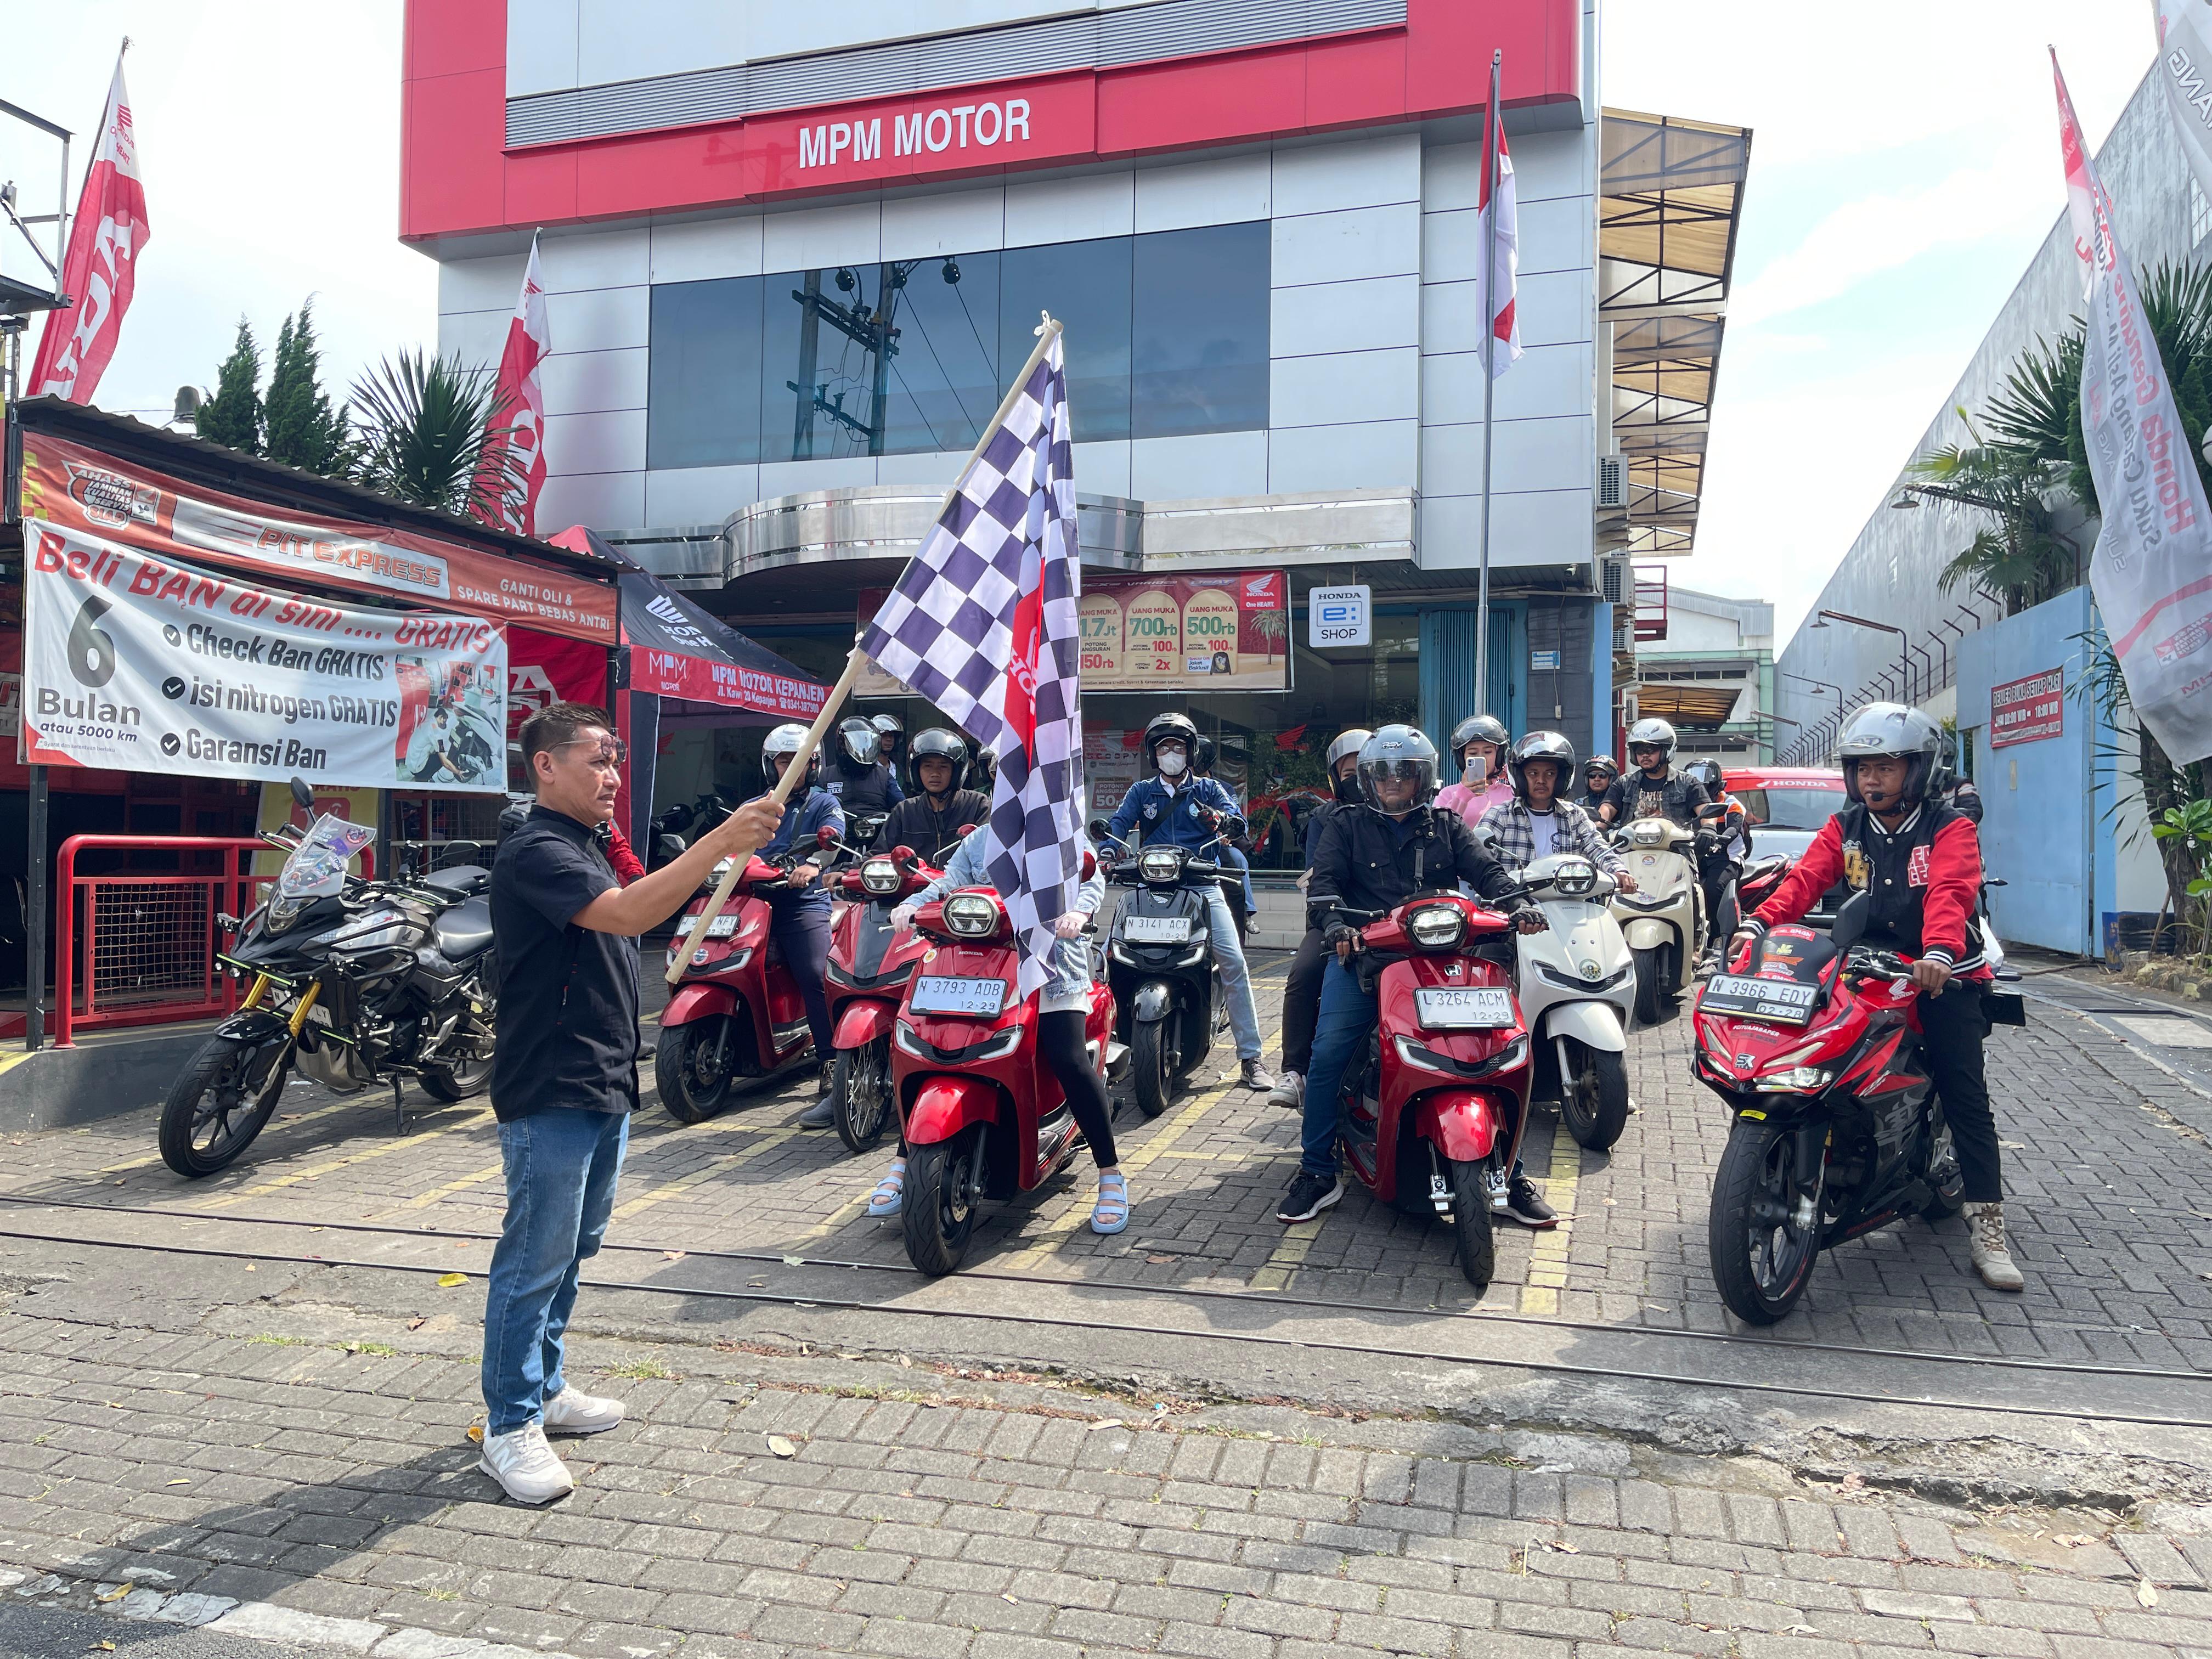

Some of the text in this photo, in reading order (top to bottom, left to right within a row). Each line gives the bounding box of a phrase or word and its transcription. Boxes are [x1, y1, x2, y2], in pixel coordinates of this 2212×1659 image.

[799, 98, 1030, 168] MPM MOTOR
[75, 469, 132, 488] AHASS
[84, 487, 131, 504] KUALITAS
[88, 481, 133, 497] JAMINAN
[94, 498, 132, 511] SERVIS
[89, 506, 125, 523] SIAP
[257, 527, 442, 588] PIT EXPRESS
[34, 531, 126, 588] Beli
[128, 555, 233, 610] BAN
[229, 585, 272, 619] di
[394, 618, 494, 654] GRATIS
[500, 578, 572, 606] GANTI OLI &
[1318, 592, 1362, 600] HONDA
[457, 585, 610, 630] SPARE PART BEBAS ANTRI
[658, 624, 702, 636] HON
[1130, 617, 1177, 636] 700rb
[1187, 616, 1235, 635] 500rb
[1321, 629, 1357, 640] SHOP
[67, 595, 115, 687] 6
[187, 623, 384, 681] Check Ban GRATIS
[649, 651, 687, 680] MPM
[1155, 659, 1171, 670] 2x
[661, 681, 680, 692] MOTOR
[712, 664, 825, 702] MPM MOTOR KEPANJEN
[1993, 673, 2062, 708] DEALER BUKA SETIAP HARI
[37, 687, 140, 726] Bulan
[189, 675, 397, 728] isi nitrogen GRATIS
[726, 687, 742, 699] Kawi
[744, 690, 751, 702] 20
[752, 692, 777, 708] Kepanjen
[40, 722, 137, 742] atau 5000 km
[187, 729, 326, 769] Garansi Ban
[1096, 795, 1121, 807] 50r
[1127, 919, 1133, 928] N
[1169, 919, 1188, 928] ACX
[919, 980, 1001, 996] N 3793 ADB
[1712, 978, 1811, 1006] N 3966 EDY
[1892, 990, 1915, 1001] HONDA
[1424, 992, 1505, 1007] L 3264 ACM
